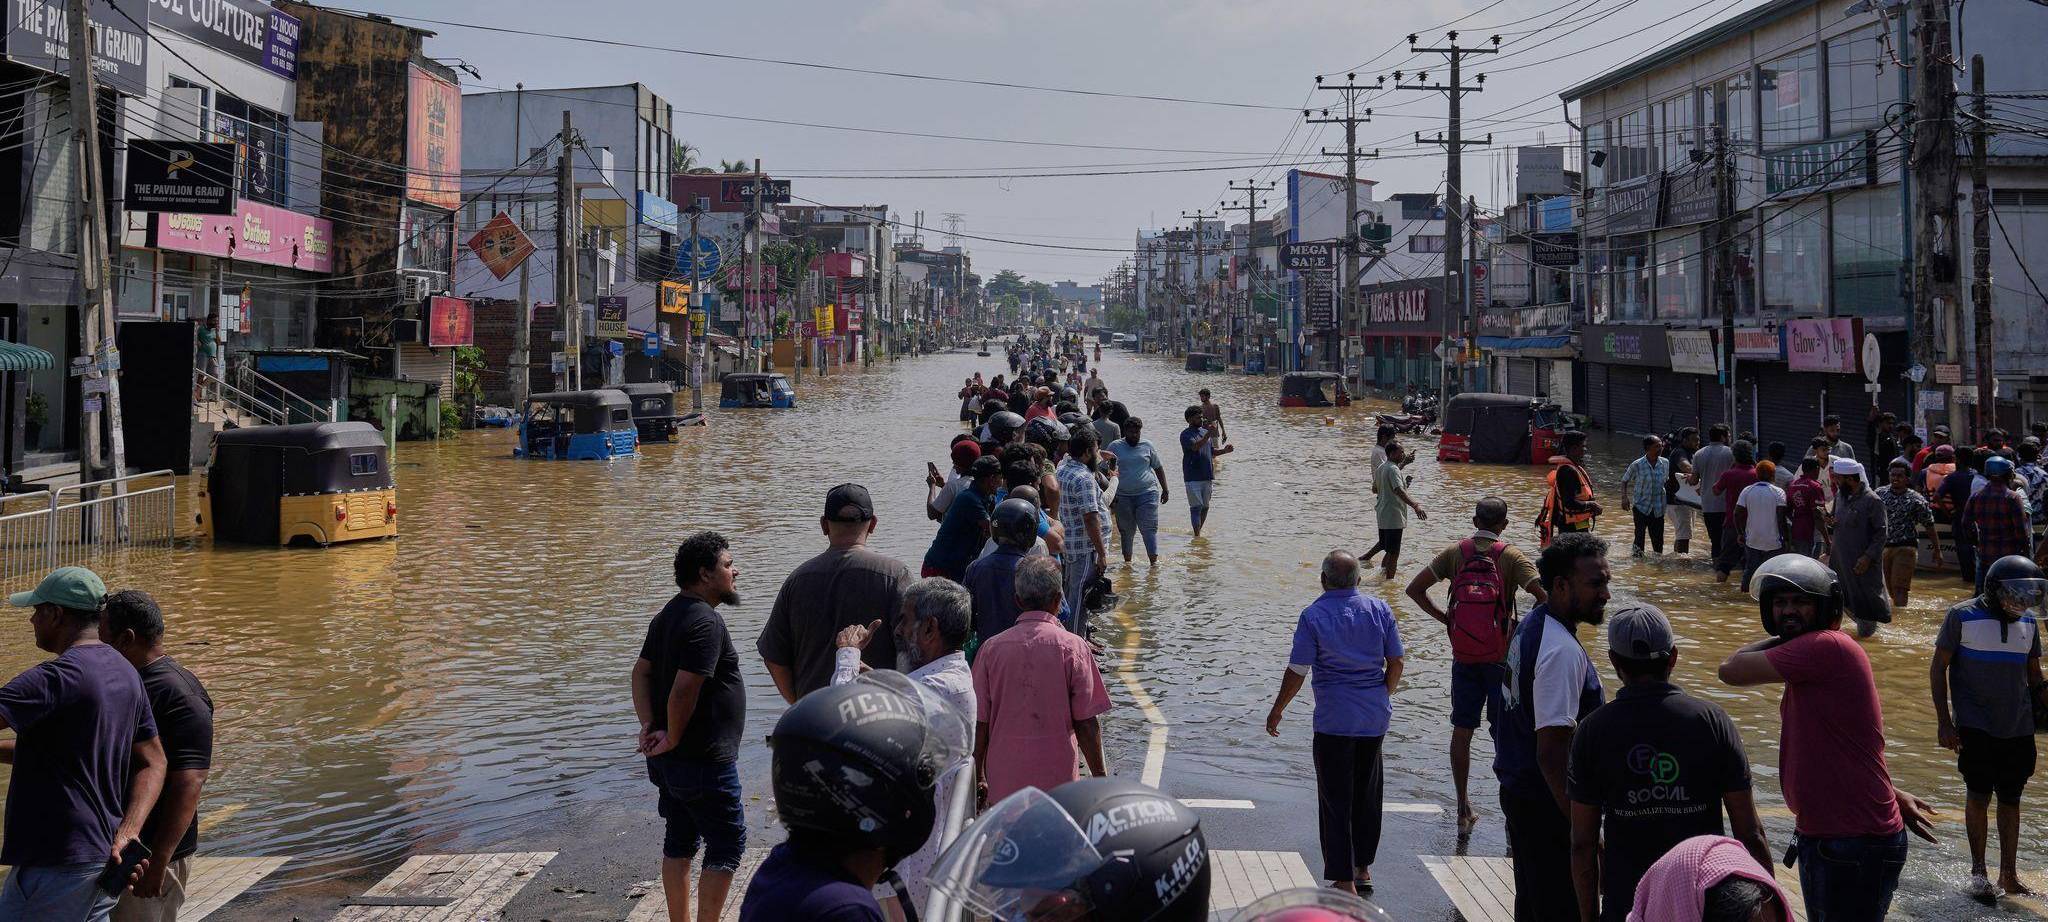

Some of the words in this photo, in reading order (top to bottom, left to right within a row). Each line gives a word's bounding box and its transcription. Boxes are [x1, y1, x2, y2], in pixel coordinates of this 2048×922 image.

[18, 0, 43, 35] THE
[105, 26, 143, 66] GRAND
[189, 0, 264, 51] CULTURE
[271, 14, 279, 31] 12
[279, 17, 299, 40] NOON
[1773, 139, 1859, 192] MADAME
[134, 183, 151, 194] THE
[152, 184, 193, 196] PAVILION
[194, 186, 225, 197] GRAND
[1289, 245, 1328, 255] MEGA
[1290, 257, 1326, 267] SALE
[1370, 292, 1396, 322] MEGA
[1398, 289, 1426, 322] SALE
[598, 322, 625, 332] HOUSE
[1615, 336, 1640, 353] STORE
[1793, 331, 1815, 353] Glow
[1832, 332, 1847, 359] Up
[1636, 748, 1650, 769] F
[1658, 759, 1673, 779] P
[1627, 785, 1690, 804] SOCIAL
[1664, 807, 1682, 815] YOUR
[1683, 803, 1707, 814] BRAND
[1083, 800, 1176, 849] ACTION
